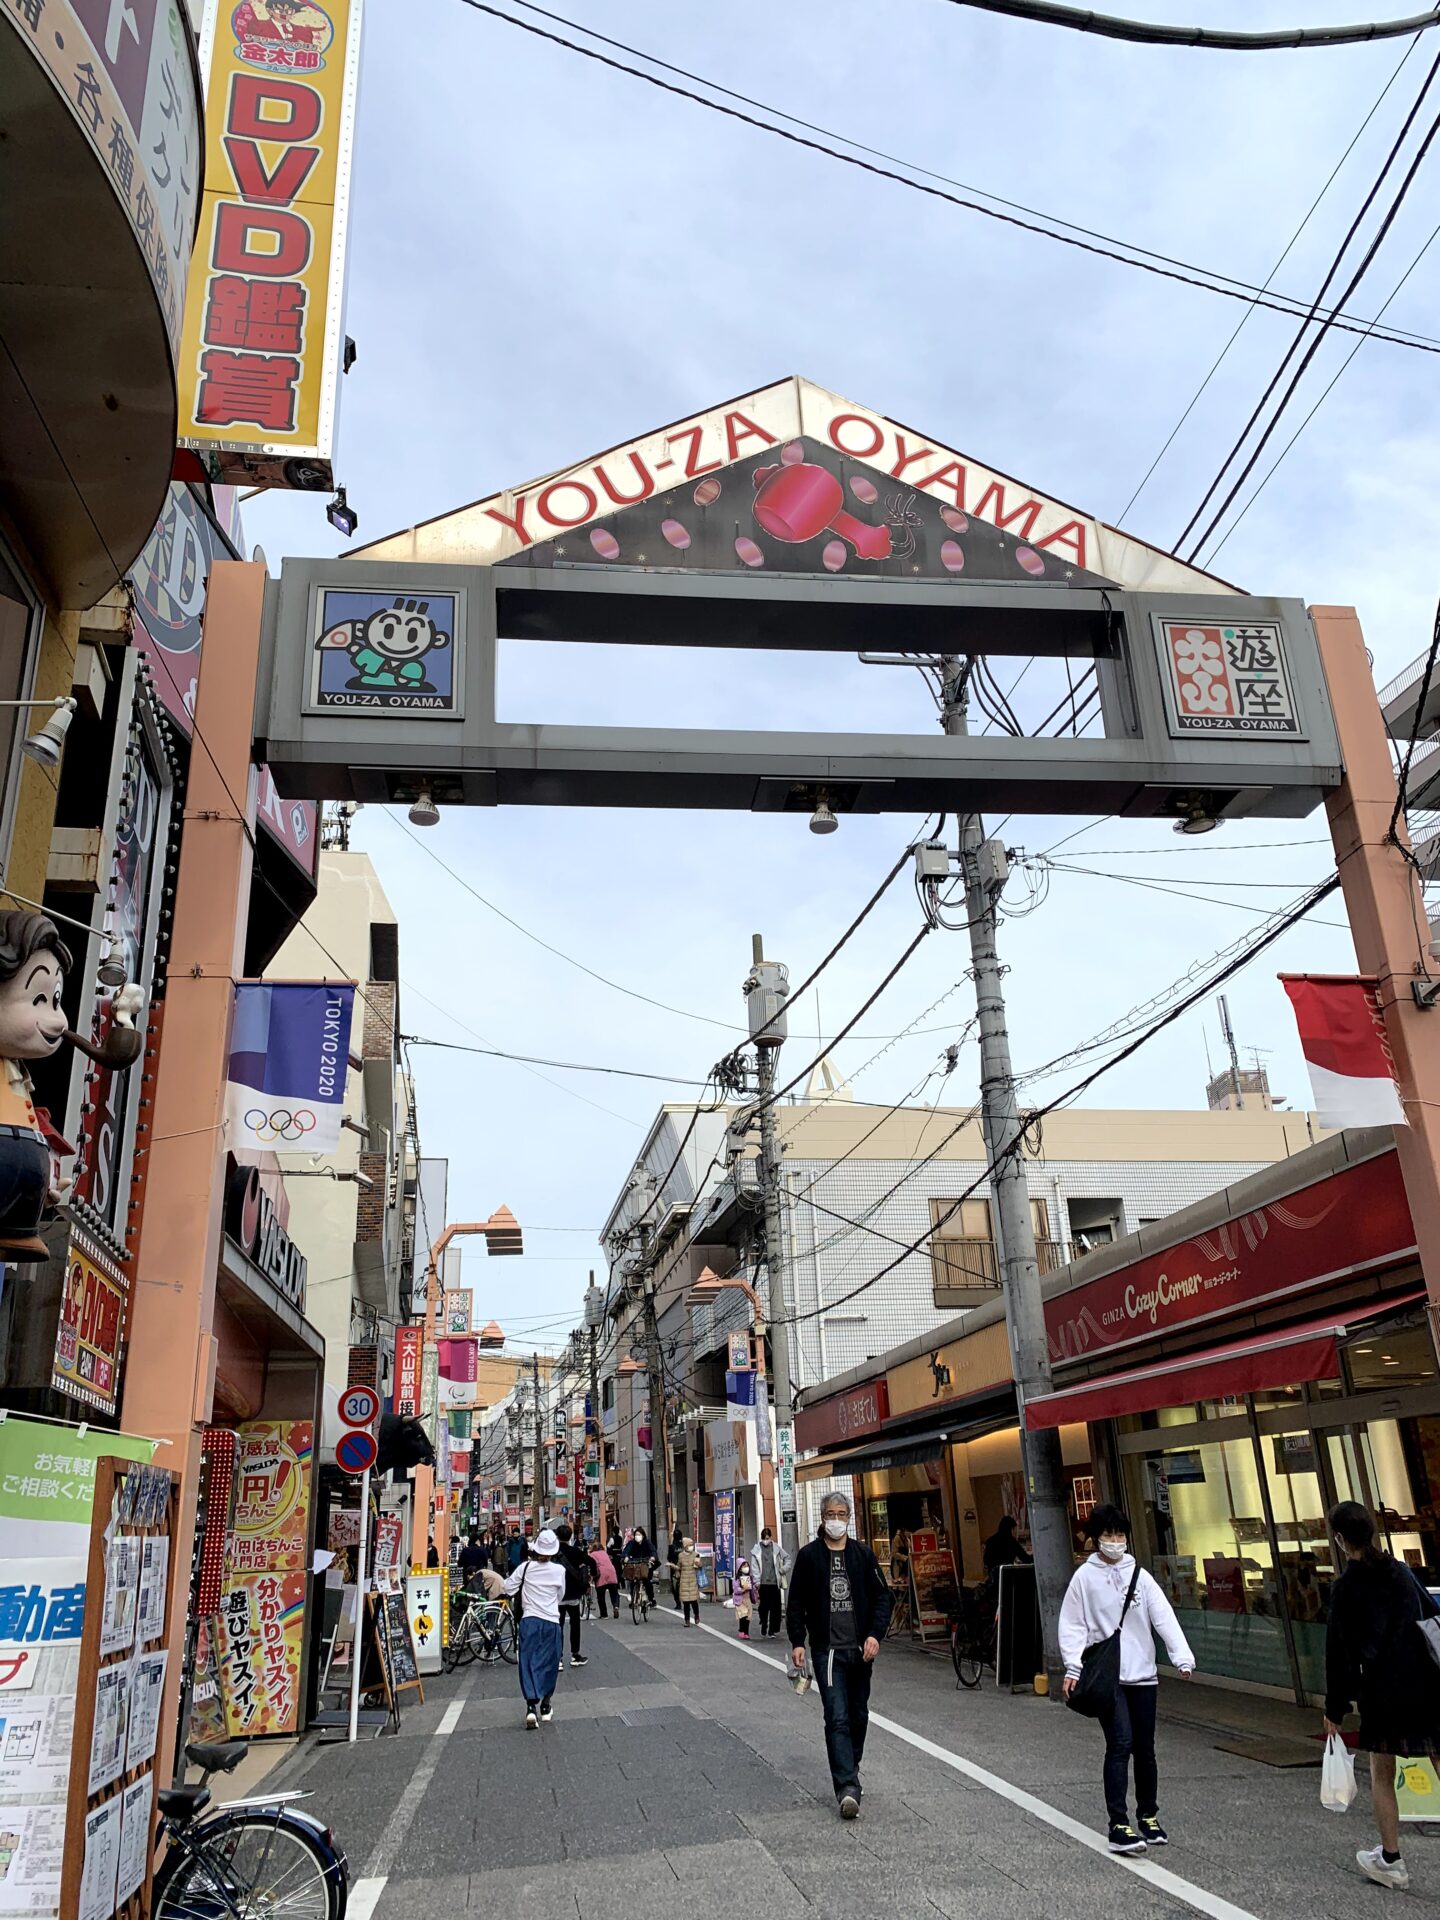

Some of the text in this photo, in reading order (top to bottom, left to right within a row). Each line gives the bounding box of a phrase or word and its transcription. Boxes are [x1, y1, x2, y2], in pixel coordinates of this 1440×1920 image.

[242, 44, 318, 68] 金太郎
[484, 410, 1088, 569] YOU-ZA OYAMA
[324, 694, 445, 708] YOU-ZA OYAMA
[1183, 718, 1290, 730] YOU-ZA OYAMA
[318, 997, 342, 1097] TOKYO 2020
[258, 1187, 308, 1315] YASUDA
[1102, 1274, 1203, 1326] GINZA Cozy Corner
[347, 1398, 371, 1417] 30
[780, 1431, 791, 1454] 鈴木
[34, 1453, 95, 1477] お気軽
[242, 1458, 279, 1474] YASUDA
[2, 1475, 93, 1502] ご相談くだ
[782, 1468, 793, 1491] 医院
[417, 1604, 429, 1646] てんや
[257, 1577, 293, 1725] 分かりヤスイ!
